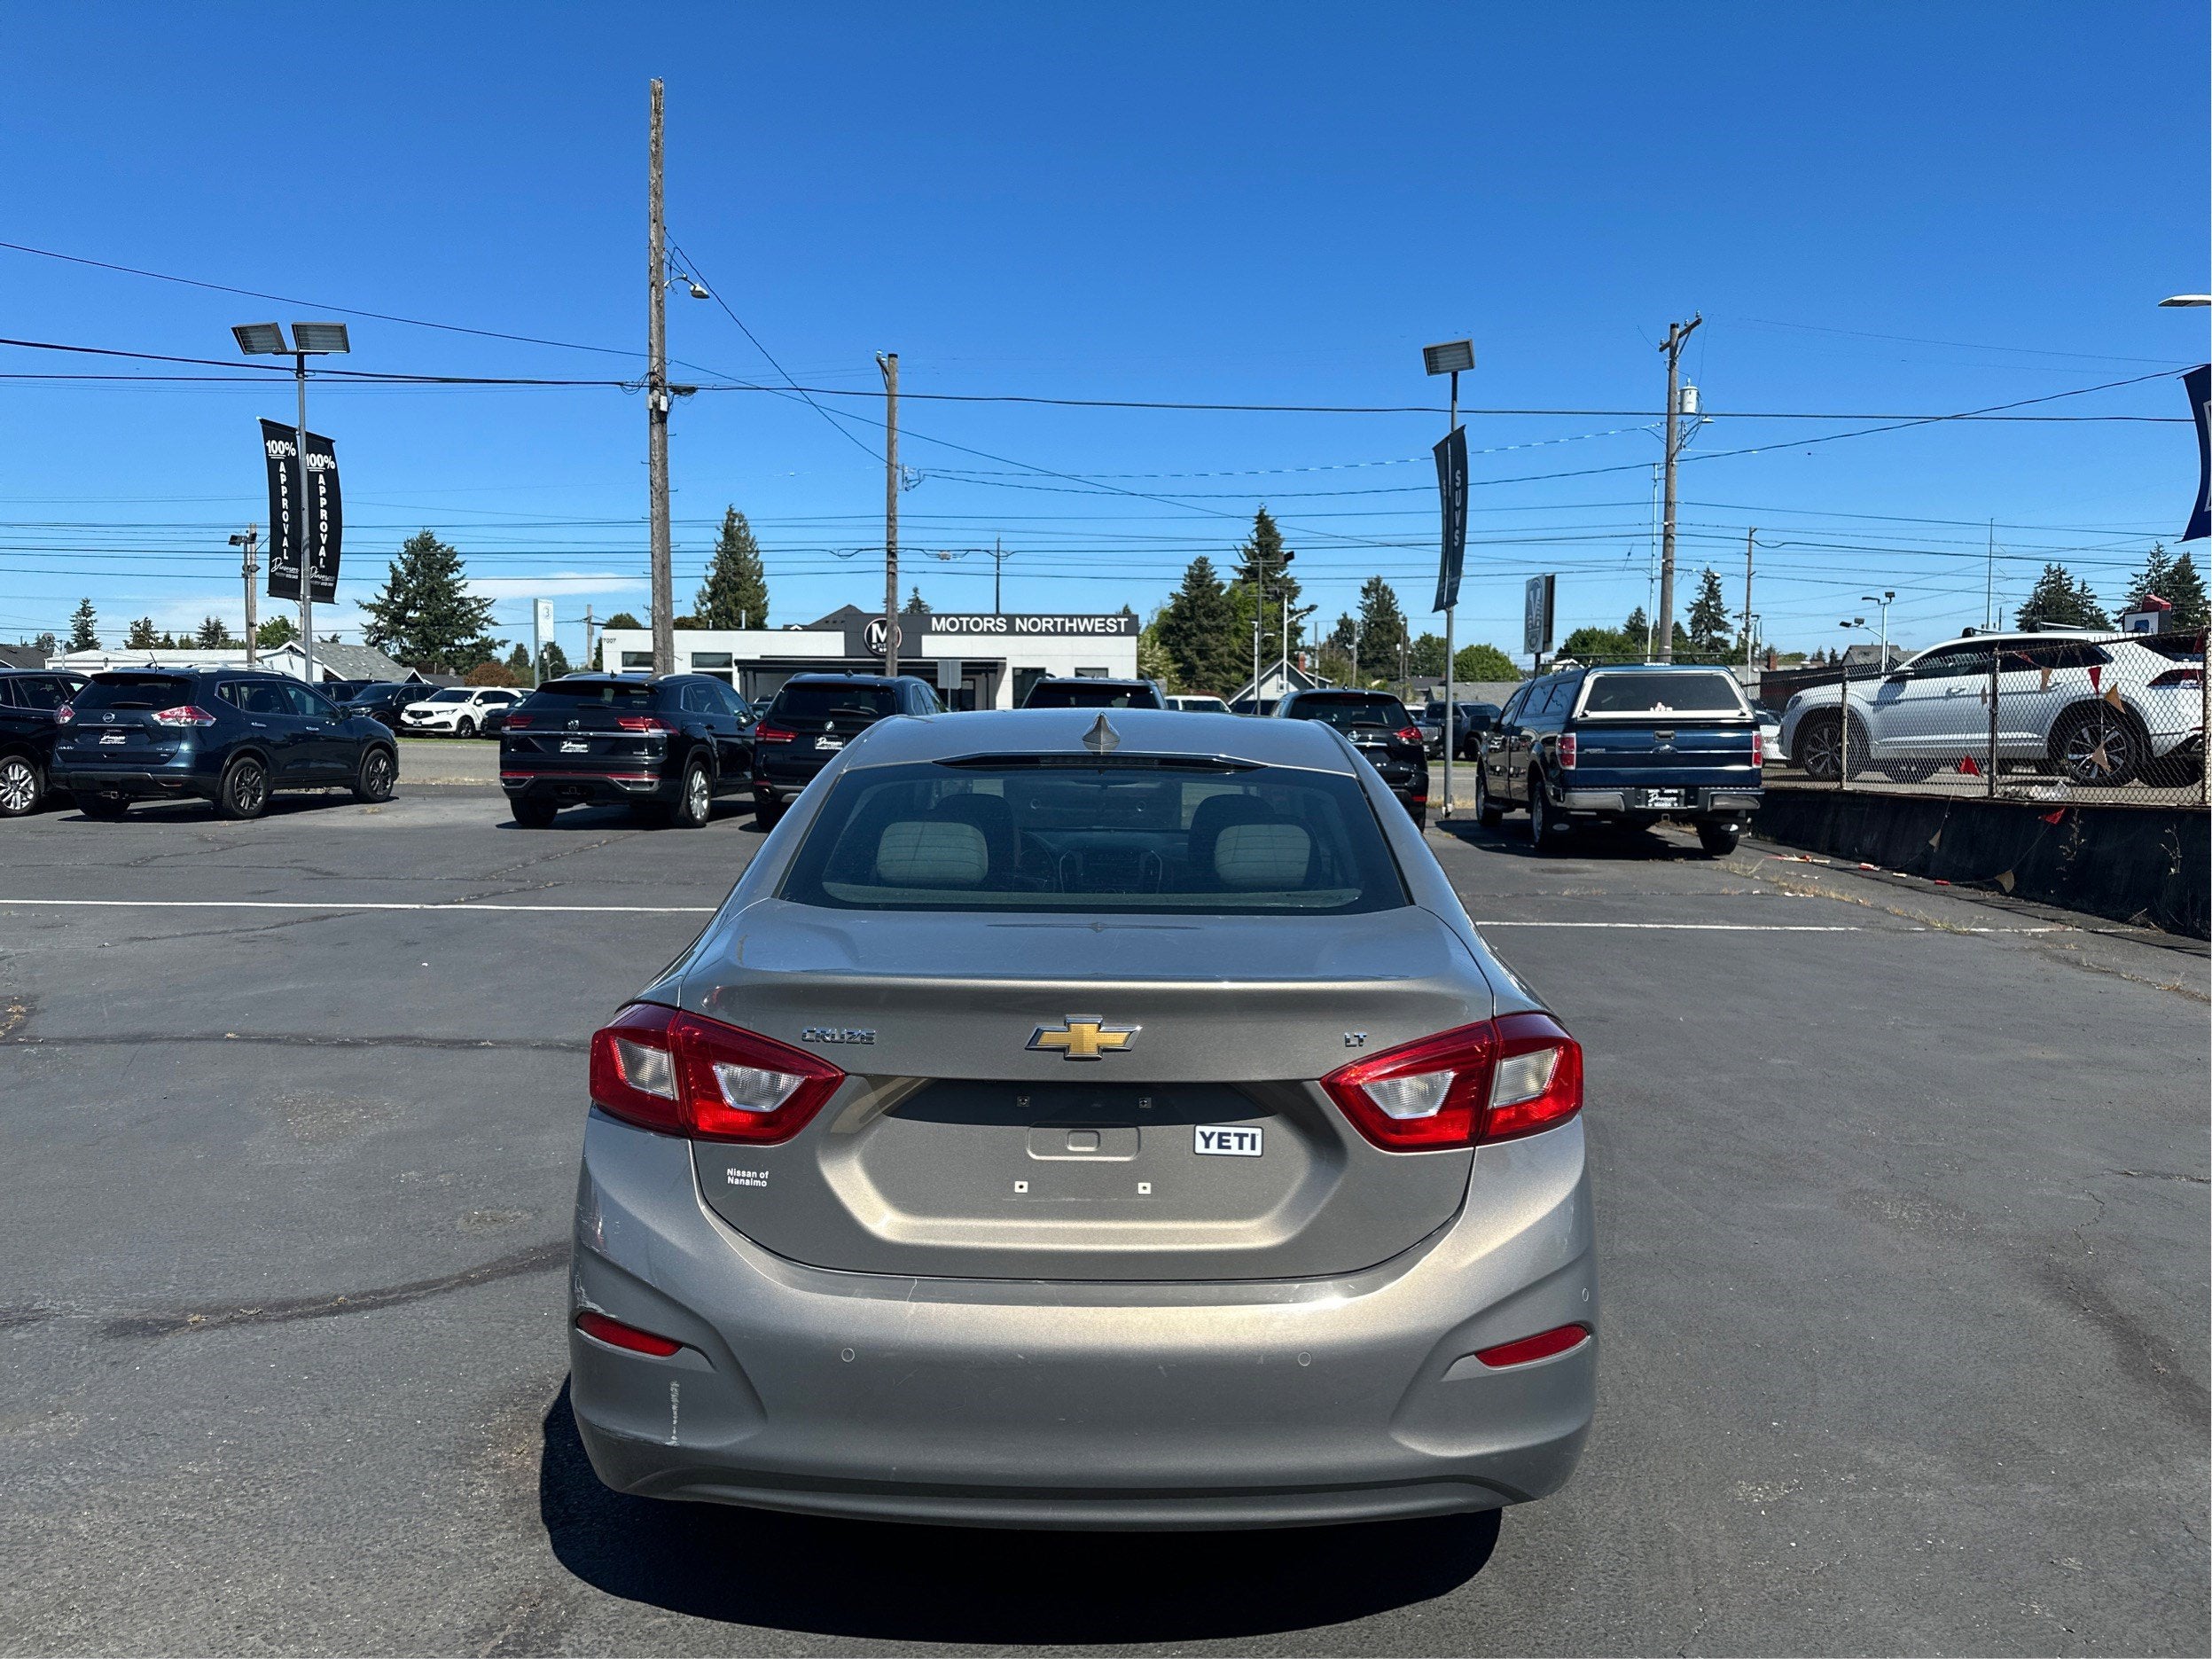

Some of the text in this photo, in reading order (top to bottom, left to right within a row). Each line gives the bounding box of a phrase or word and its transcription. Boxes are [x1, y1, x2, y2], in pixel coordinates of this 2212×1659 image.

[266, 440, 296, 457] 100%
[306, 453, 336, 470] 100%
[278, 461, 289, 560] APPROVAL
[317, 473, 329, 568] APPROVAL
[931, 617, 1129, 632] MOTORS NORTHWEST
[801, 1027, 876, 1045] CRUZE
[1344, 1032, 1368, 1048] LT
[1199, 1131, 1257, 1151] YETI
[727, 1168, 770, 1179] Nissan of
[727, 1176, 768, 1187] Nanaimo
